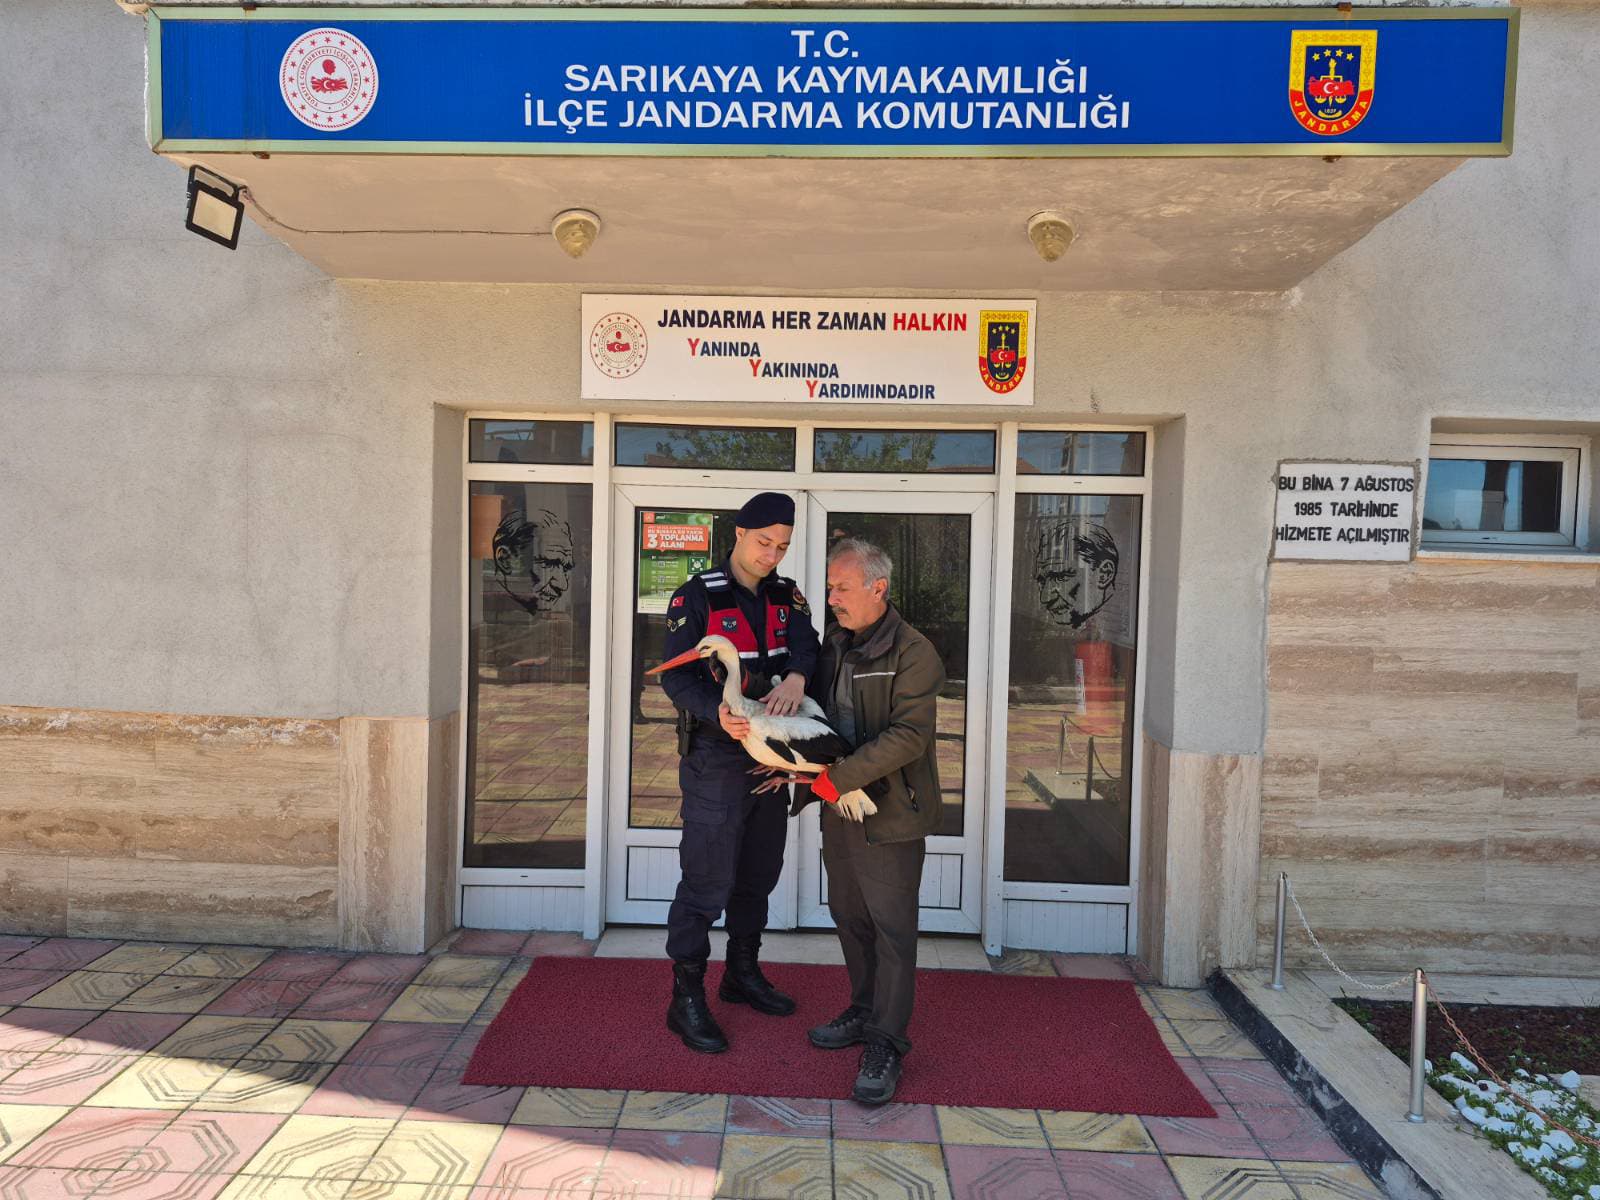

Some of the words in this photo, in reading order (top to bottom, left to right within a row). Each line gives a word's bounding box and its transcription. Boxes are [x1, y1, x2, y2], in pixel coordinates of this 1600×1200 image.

[791, 29, 859, 58] T.C.
[564, 64, 763, 93] SARIKAYA
[776, 58, 1088, 95] KAYMAKAMLIĞI
[523, 93, 608, 134] İLÇE
[618, 100, 844, 129] JANDARMA
[856, 94, 1131, 130] KOMUTANLIĞI
[1294, 100, 1368, 132] JANDARMA
[657, 309, 766, 330] JANDARMA
[771, 311, 812, 330] HER
[817, 312, 886, 331] ZAMAN
[892, 312, 967, 332] HALKIN
[688, 338, 761, 358] YANINDA
[748, 359, 839, 379] YAKININDA
[806, 379, 935, 400] YARDIMINDADIR
[1278, 476, 1296, 491] BU
[1302, 474, 1334, 491] BİNA
[1341, 477, 1349, 491] 7
[1354, 475, 1414, 492] AĞUSTOS
[1294, 502, 1322, 516] 1985
[1330, 500, 1399, 517] TARİHİNDE
[659, 534, 704, 542] TOPLANMA
[1275, 524, 1332, 541] HİZMETE
[1337, 528, 1409, 545] AÇILMIŞTIR
